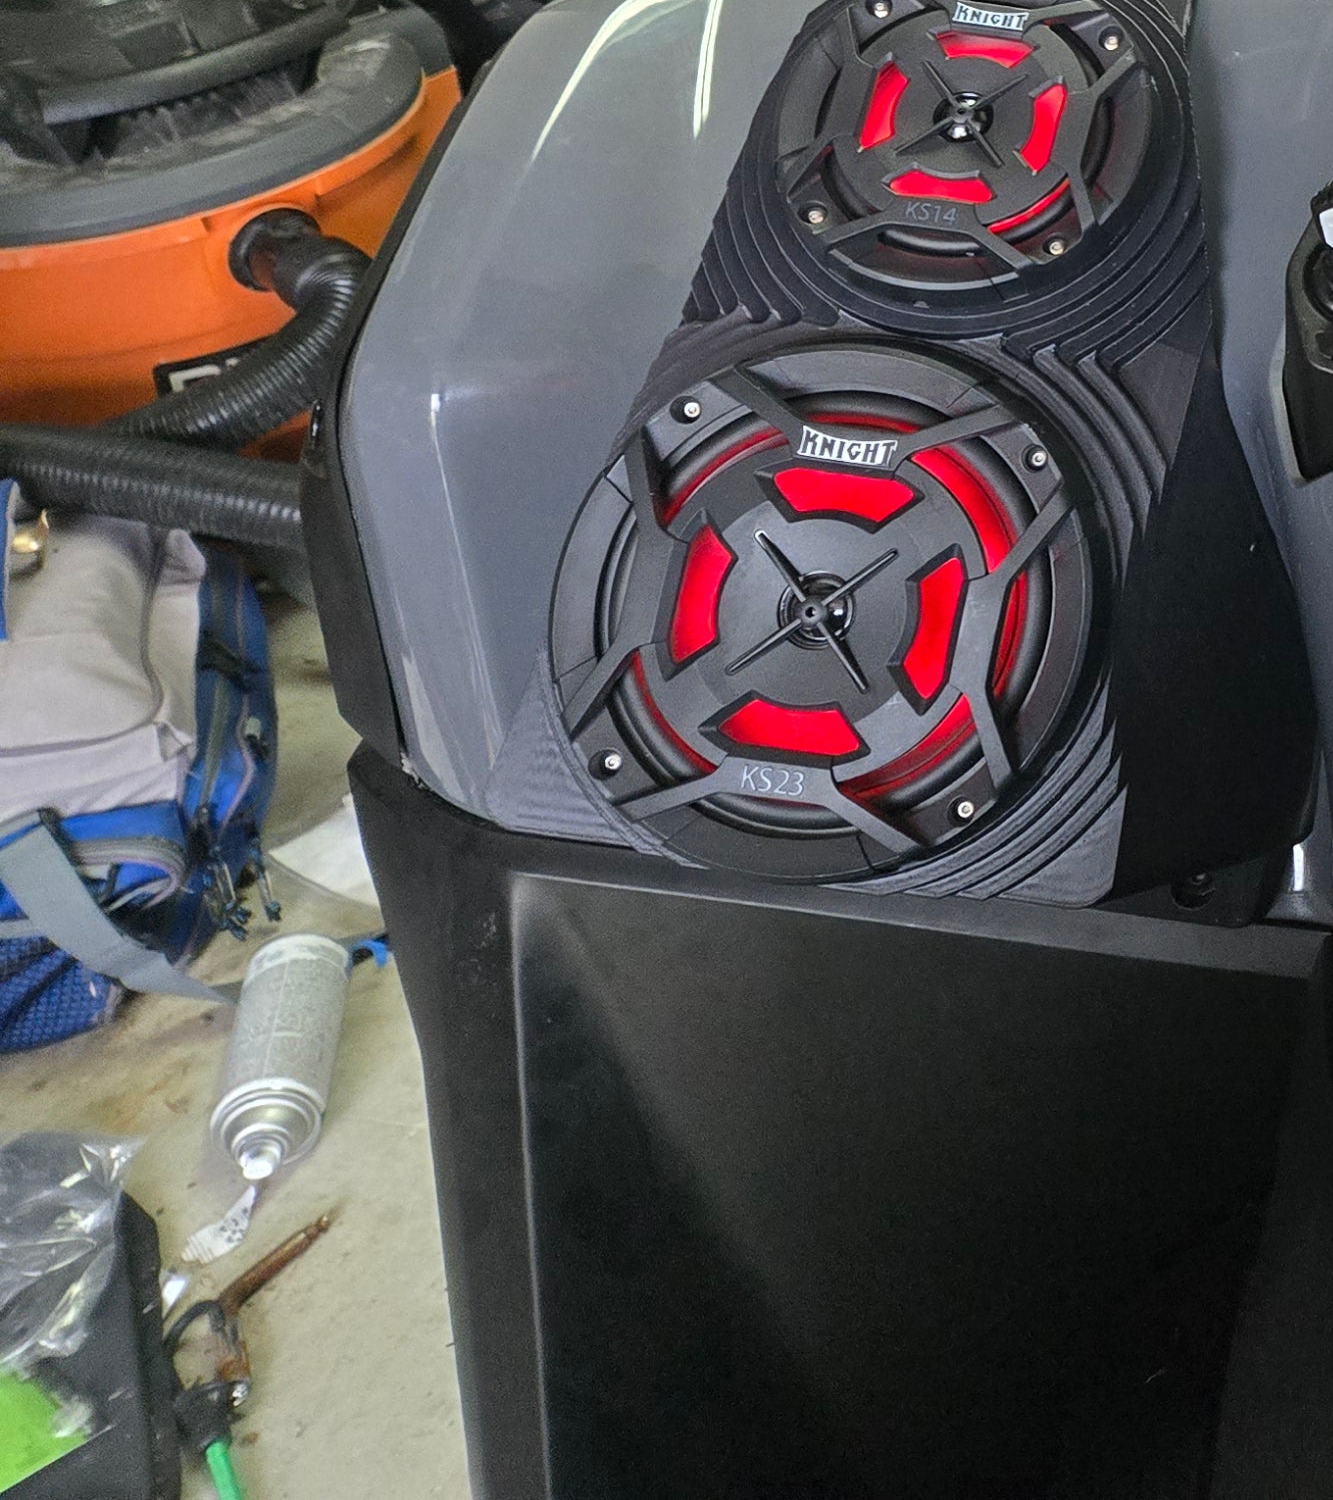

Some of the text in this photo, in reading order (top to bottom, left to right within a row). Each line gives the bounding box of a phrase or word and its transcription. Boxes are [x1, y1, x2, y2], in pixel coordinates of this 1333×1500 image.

[956, 4, 1027, 29] KNIGHT
[905, 200, 958, 226] KS14
[801, 429, 897, 467] KNIGHT
[741, 765, 804, 796] KS23
